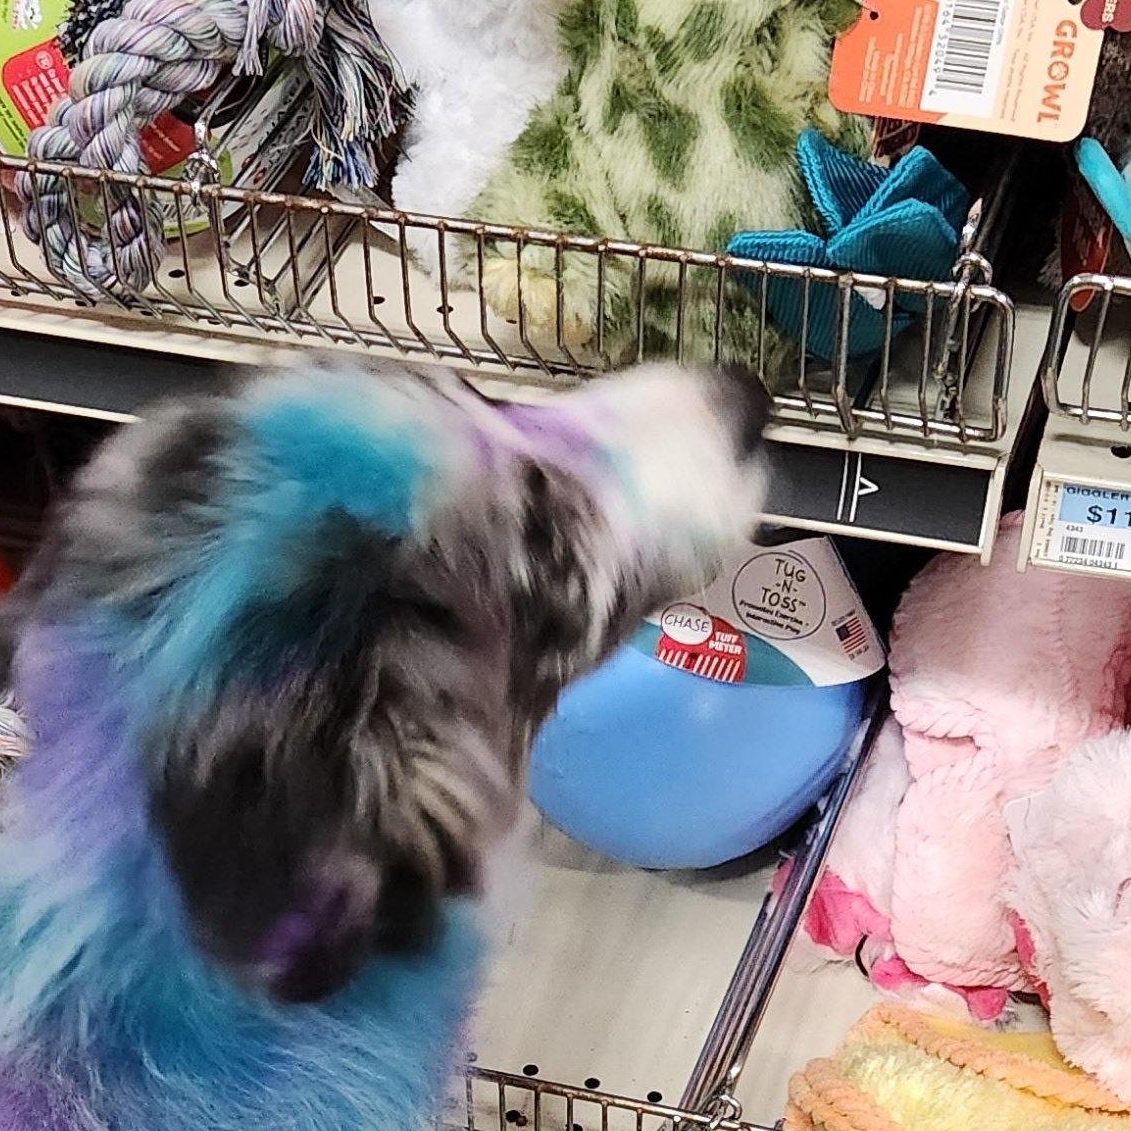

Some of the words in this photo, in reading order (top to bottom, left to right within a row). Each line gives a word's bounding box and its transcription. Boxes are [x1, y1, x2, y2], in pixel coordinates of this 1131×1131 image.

[1036, 19, 1078, 122] GROWL
[775, 559, 806, 582] TUG
[664, 613, 709, 632] CHASE
